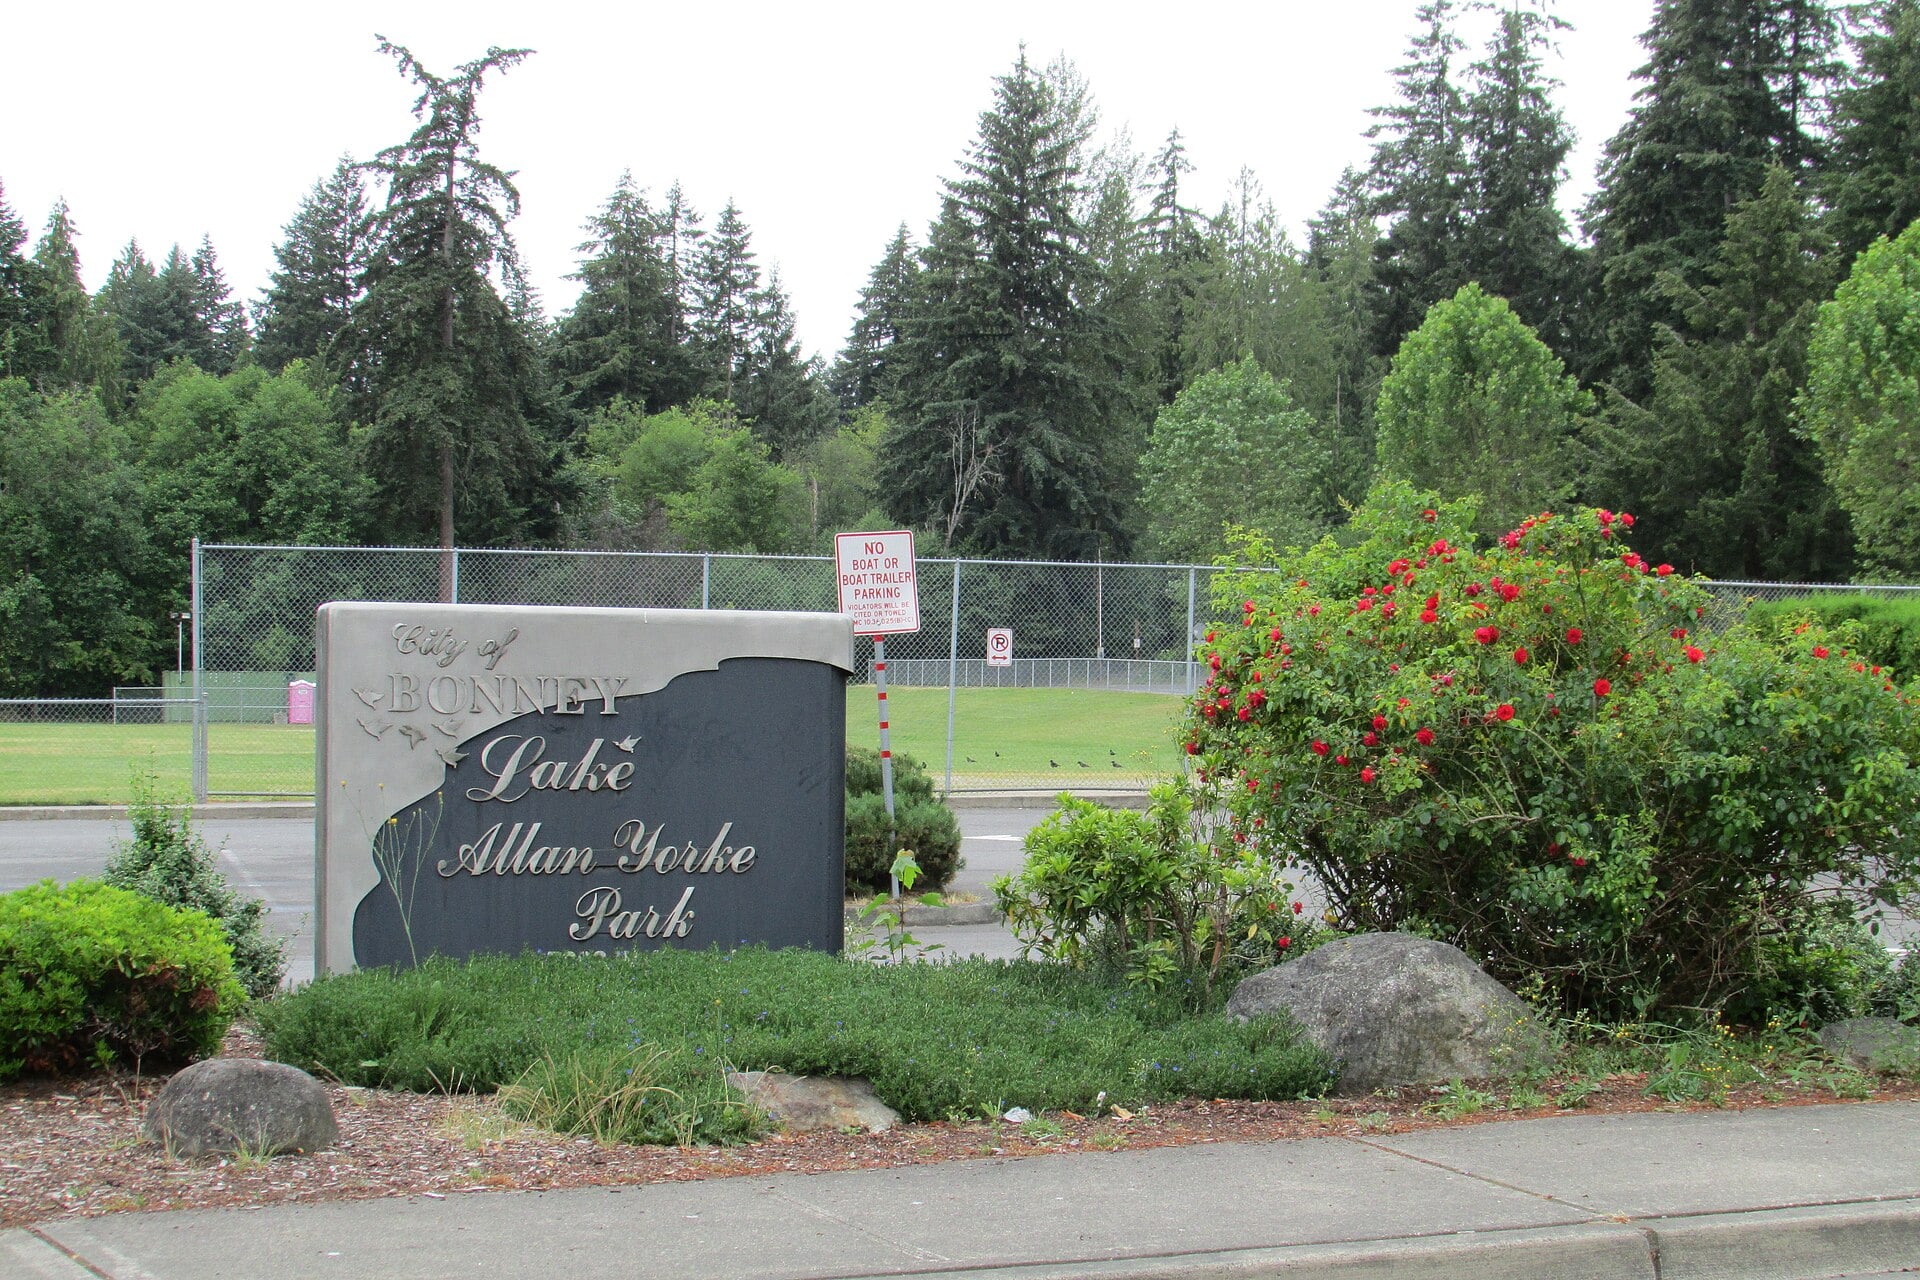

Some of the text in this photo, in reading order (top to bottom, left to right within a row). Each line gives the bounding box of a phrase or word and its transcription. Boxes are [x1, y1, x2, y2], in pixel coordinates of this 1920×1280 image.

[865, 542, 884, 554] NO
[852, 557, 899, 570] BOAT OR
[842, 572, 911, 585] BOAT TRAILER
[854, 587, 900, 599] PARKING
[848, 603, 882, 611] VIOLATORS
[853, 610, 872, 618] CITED
[885, 609, 906, 617] TOWED
[392, 622, 520, 671] City of
[387, 672, 629, 716] BONNEY
[465, 734, 636, 803] Lake
[437, 819, 758, 878] Allan Yorke
[568, 886, 696, 943] Park
